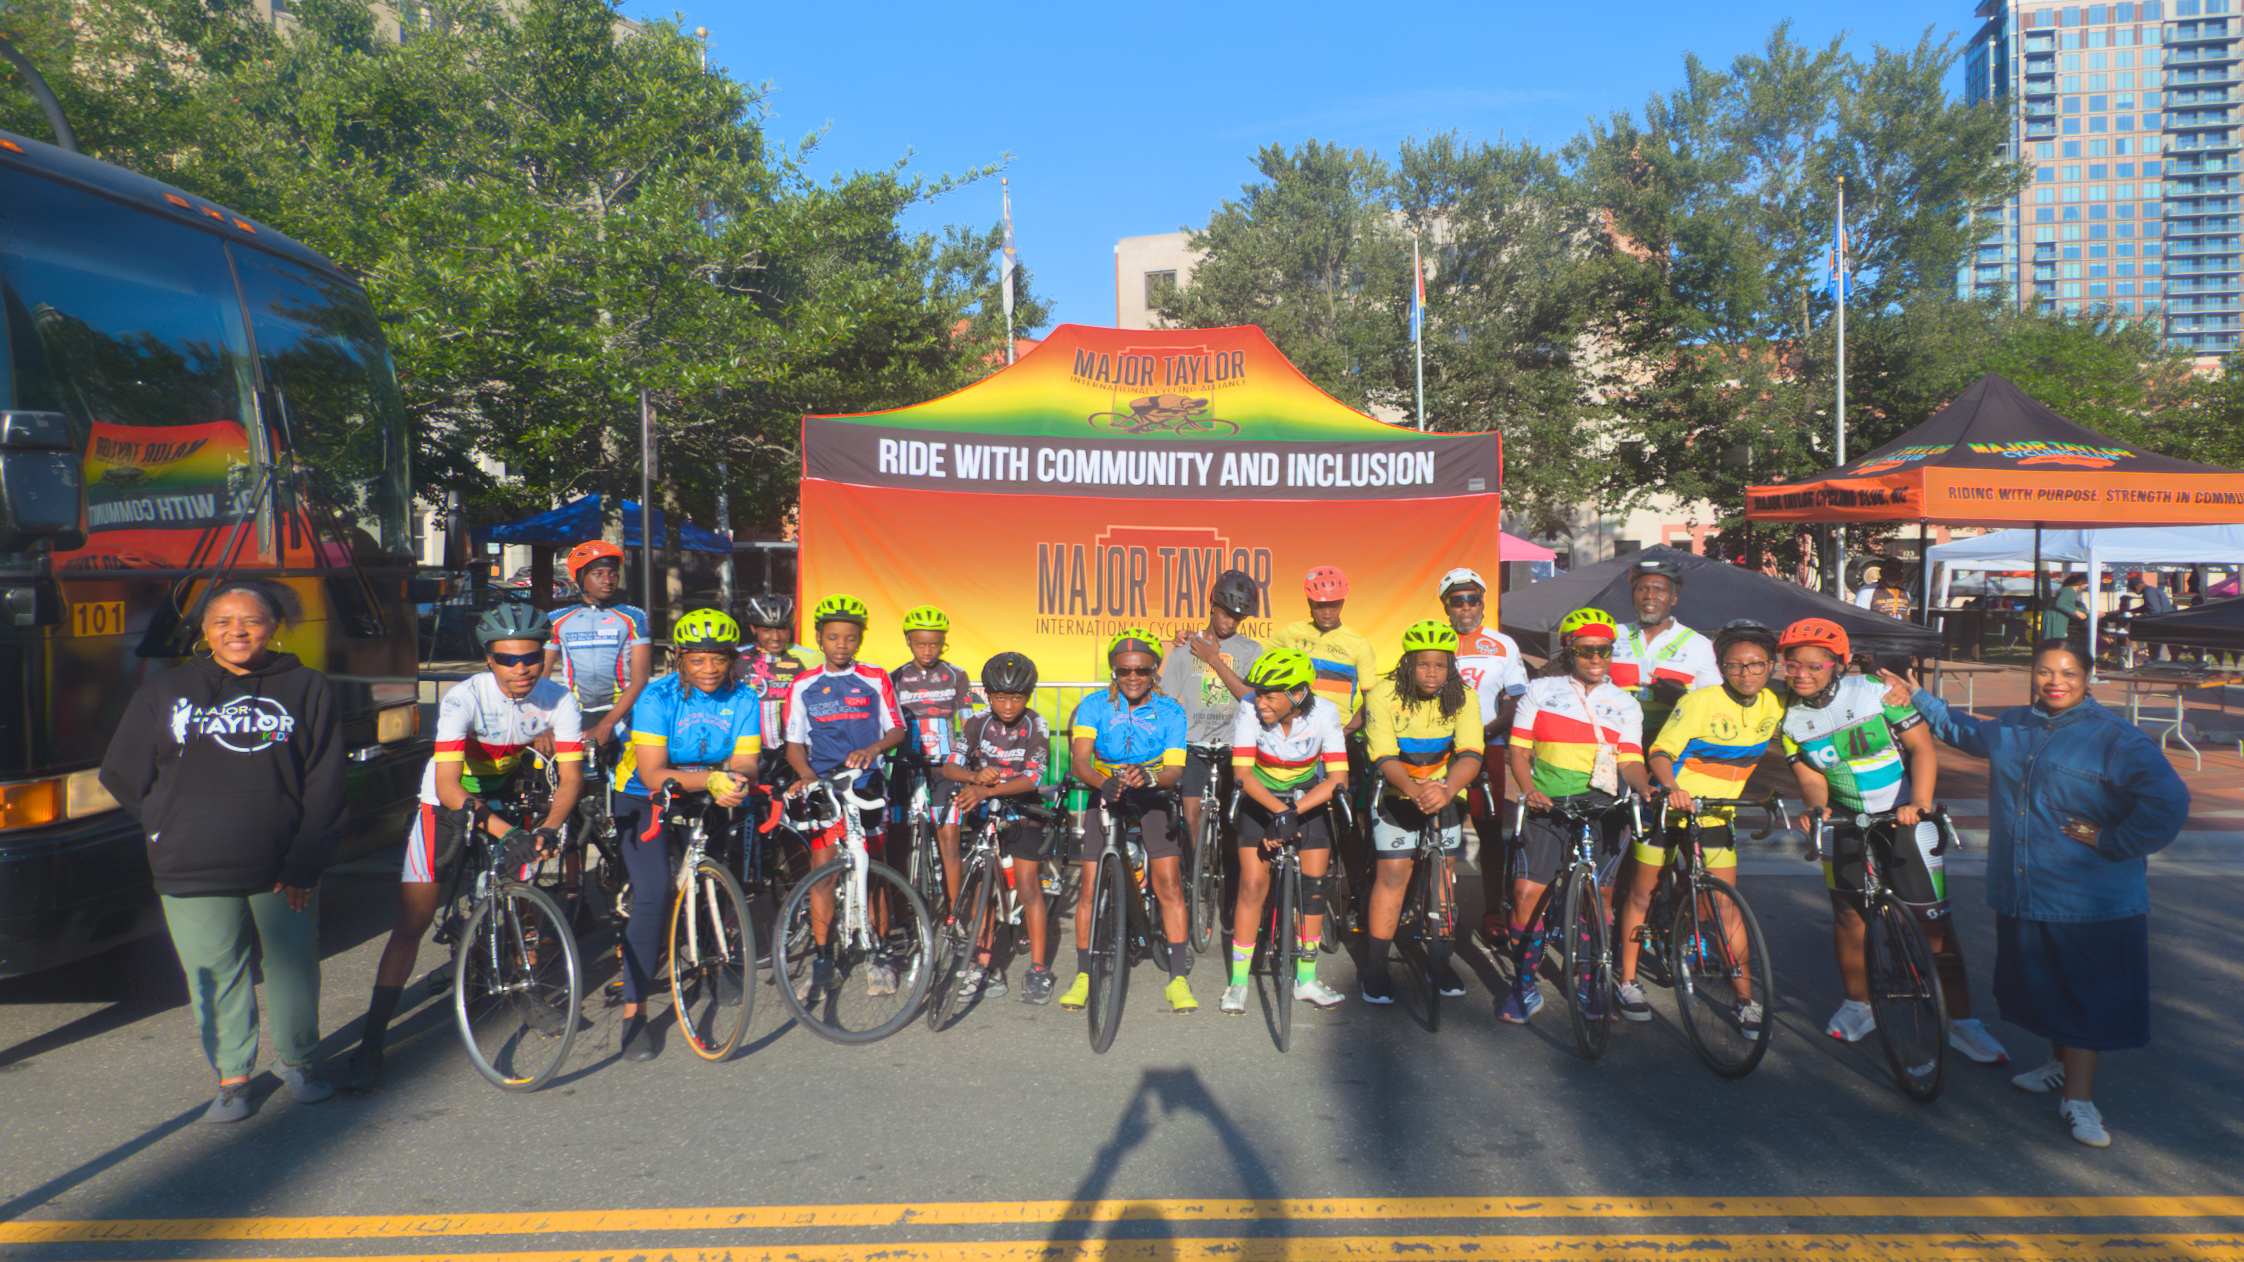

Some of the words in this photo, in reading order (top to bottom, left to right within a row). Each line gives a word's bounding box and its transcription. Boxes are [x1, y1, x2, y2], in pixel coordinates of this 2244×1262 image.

[1073, 347, 1156, 386] MAJOR
[1163, 350, 1246, 387] TAYLOR
[1070, 375, 1150, 394] INTERNATIONAL
[1201, 379, 1248, 392] ALLIANCE
[1967, 440, 2051, 454] MAJOR
[2047, 440, 2138, 458] TAYLOR
[879, 438, 947, 478] RIDE
[954, 444, 1029, 481] WITH
[1037, 447, 1214, 486] COMMUNITY
[1219, 452, 1279, 487] AND
[1287, 451, 1435, 487] INCLUSION
[1754, 494, 1783, 510] MAJOR
[1783, 491, 1815, 509] TAYLOR
[1815, 489, 1857, 507] CYCLING
[1890, 485, 1909, 504] NC
[1948, 486, 1994, 500] RIDING
[1998, 488, 2034, 501] WITH
[2106, 489, 2172, 503] STRENGTH
[2176, 491, 2190, 504] IN
[1037, 543, 1148, 618] MAJOR
[78, 603, 121, 635] 101
[809, 700, 840, 712] GEORGIA
[1808, 745, 1840, 769] 19
